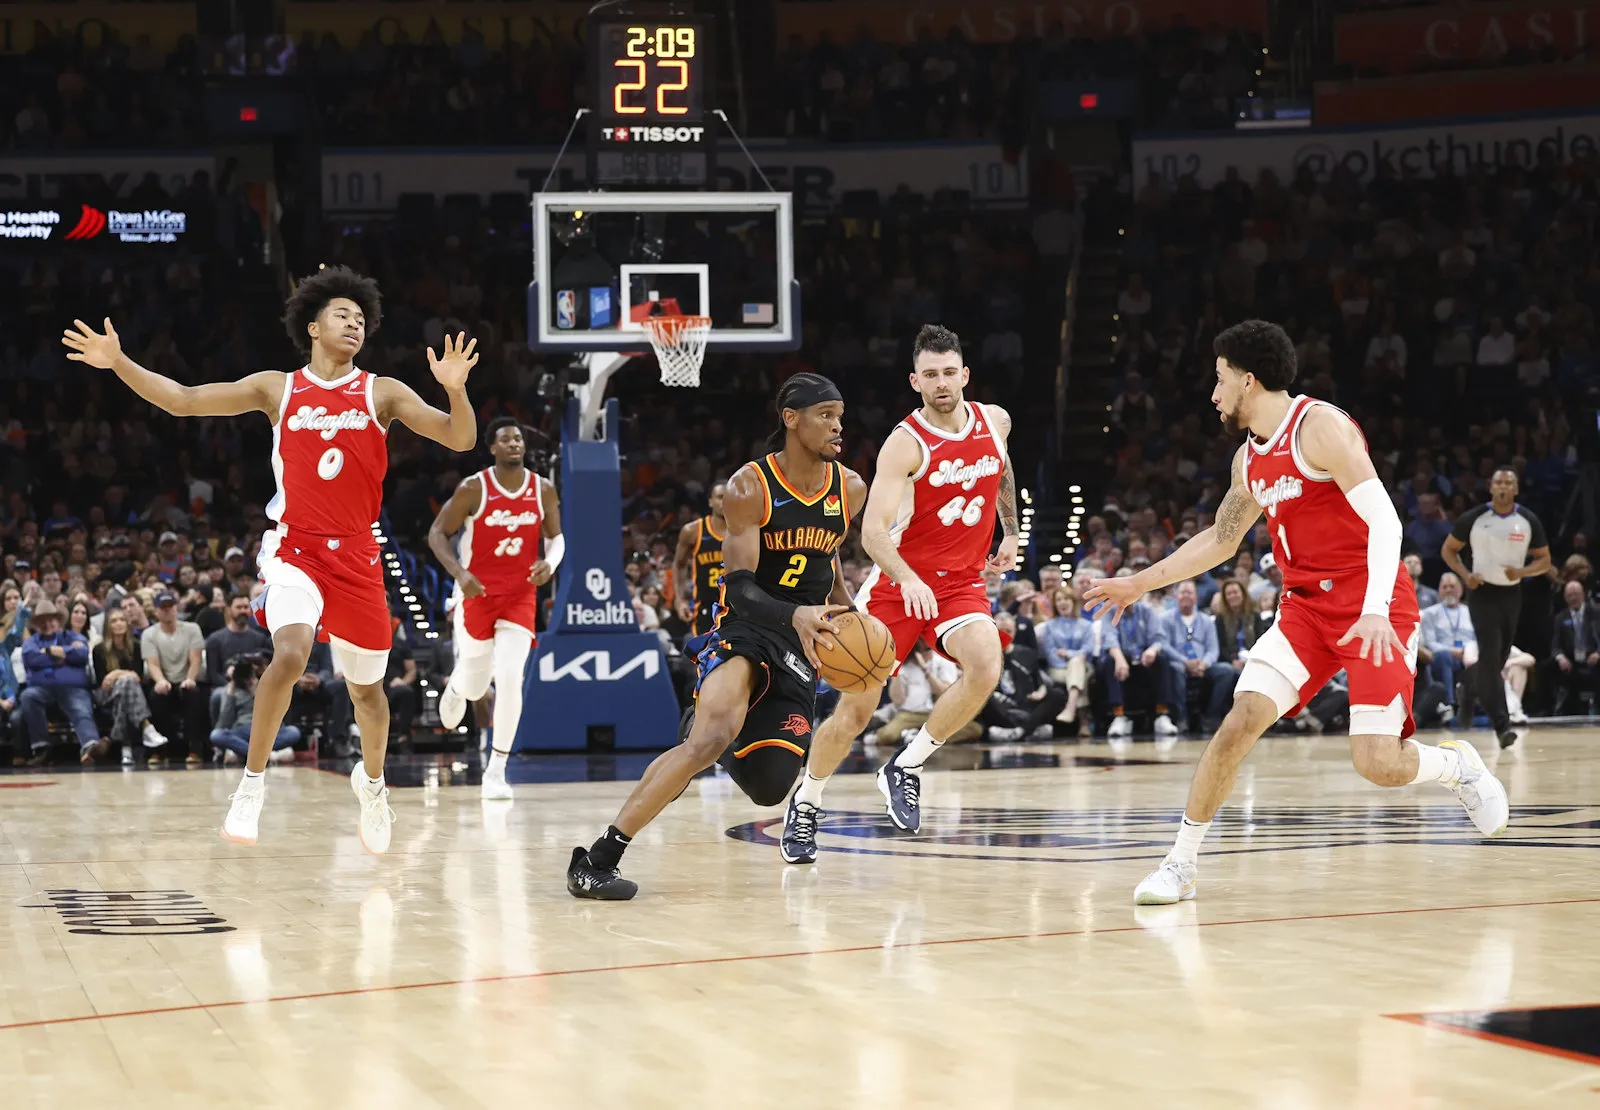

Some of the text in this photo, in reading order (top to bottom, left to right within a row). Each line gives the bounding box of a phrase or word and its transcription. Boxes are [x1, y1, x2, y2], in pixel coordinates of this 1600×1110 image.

[627, 27, 695, 58] 2:09
[614, 59, 689, 114] 22
[630, 126, 704, 142] TISSOT
[329, 171, 384, 205] 101
[516, 165, 836, 201] TDER
[7, 210, 60, 225] Health
[108, 210, 142, 224] Dean
[287, 405, 371, 440] Memphis
[317, 447, 344, 480] 0
[928, 454, 1001, 491] Memphis
[936, 495, 985, 527] 46
[1251, 475, 1303, 518] Memphis
[484, 509, 538, 532] Memphis
[494, 537, 523, 556] 13
[779, 553, 807, 588] 2
[566, 600, 634, 625] Health
[539, 649, 660, 682] KIA
